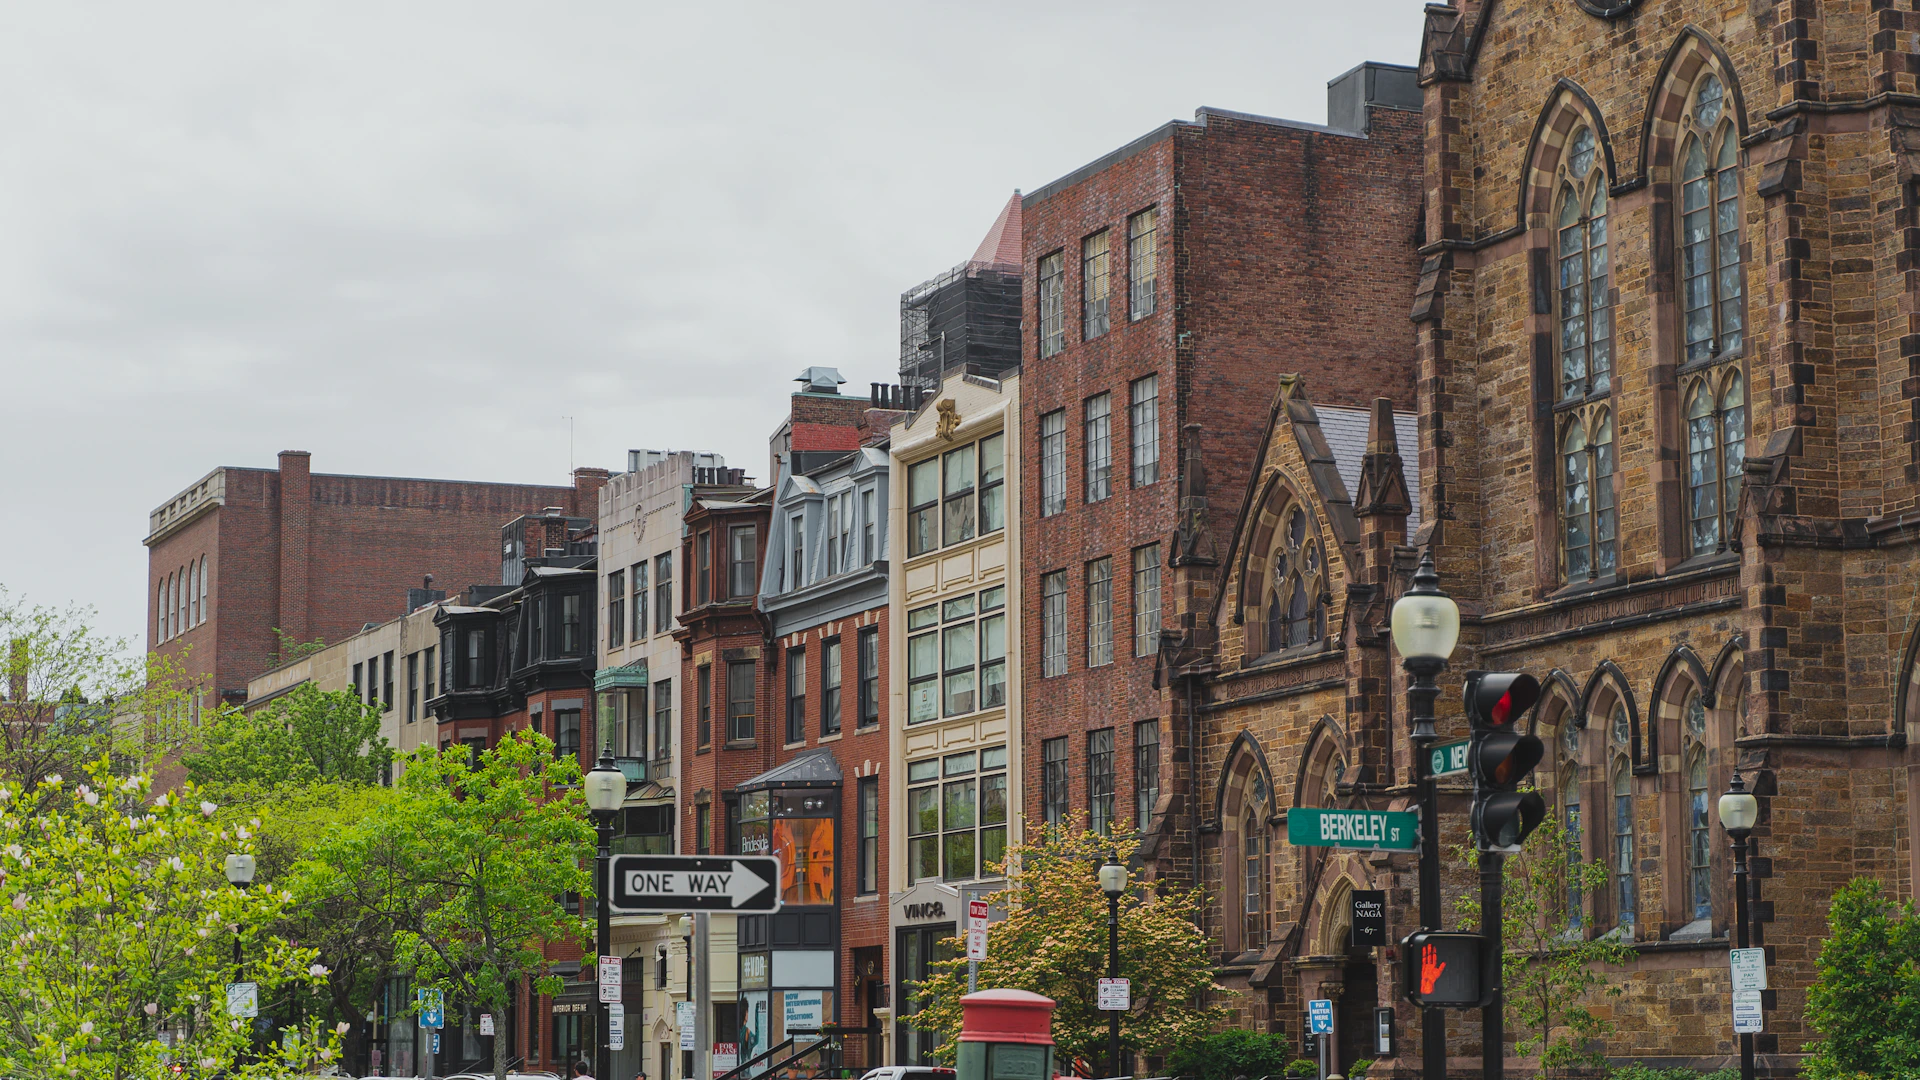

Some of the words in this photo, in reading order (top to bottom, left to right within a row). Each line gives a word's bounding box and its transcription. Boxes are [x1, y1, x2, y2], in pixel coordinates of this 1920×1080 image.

[1320, 813, 1387, 841] BERKELEY
[1390, 827, 1400, 841] ST
[632, 874, 674, 893] ONE
[688, 874, 731, 893] WAY
[1355, 901, 1381, 910] Gallery
[1732, 952, 1739, 960] 2
[786, 999, 821, 1007] INTERVIEWING
